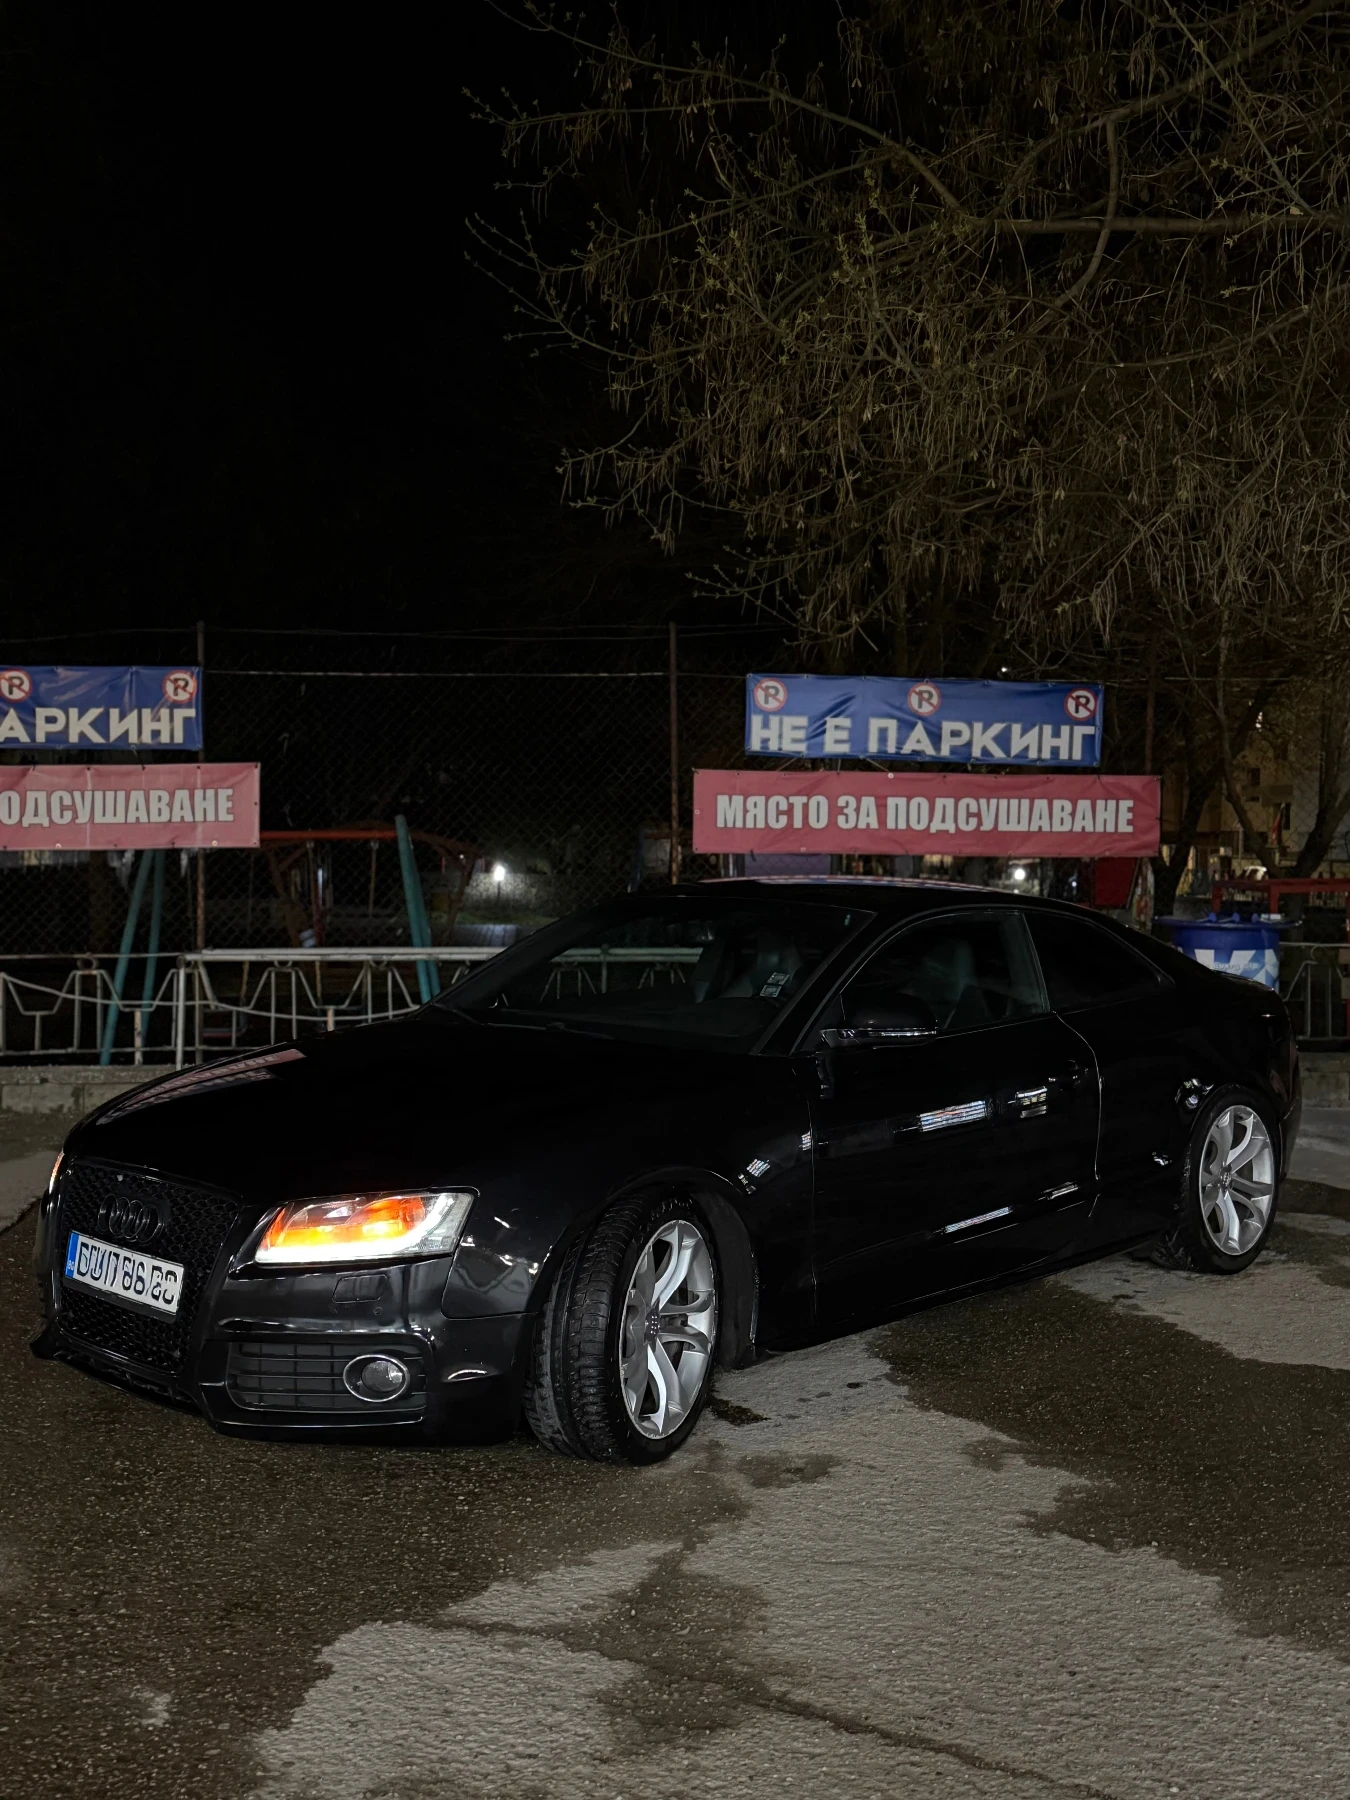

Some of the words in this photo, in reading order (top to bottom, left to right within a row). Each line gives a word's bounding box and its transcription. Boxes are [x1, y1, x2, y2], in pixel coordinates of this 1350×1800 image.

[0, 707, 197, 744] АРКИНГ
[751, 714, 809, 752] НЕ
[823, 717, 852, 753] Е
[868, 716, 1095, 761] ПАРКИНГ
[0, 787, 235, 828] ОДСУШАВАНЕ
[716, 794, 829, 829] МЯСТО
[836, 795, 879, 830] ЗА
[886, 796, 1134, 834] ПОДСУШАВАНЕ
